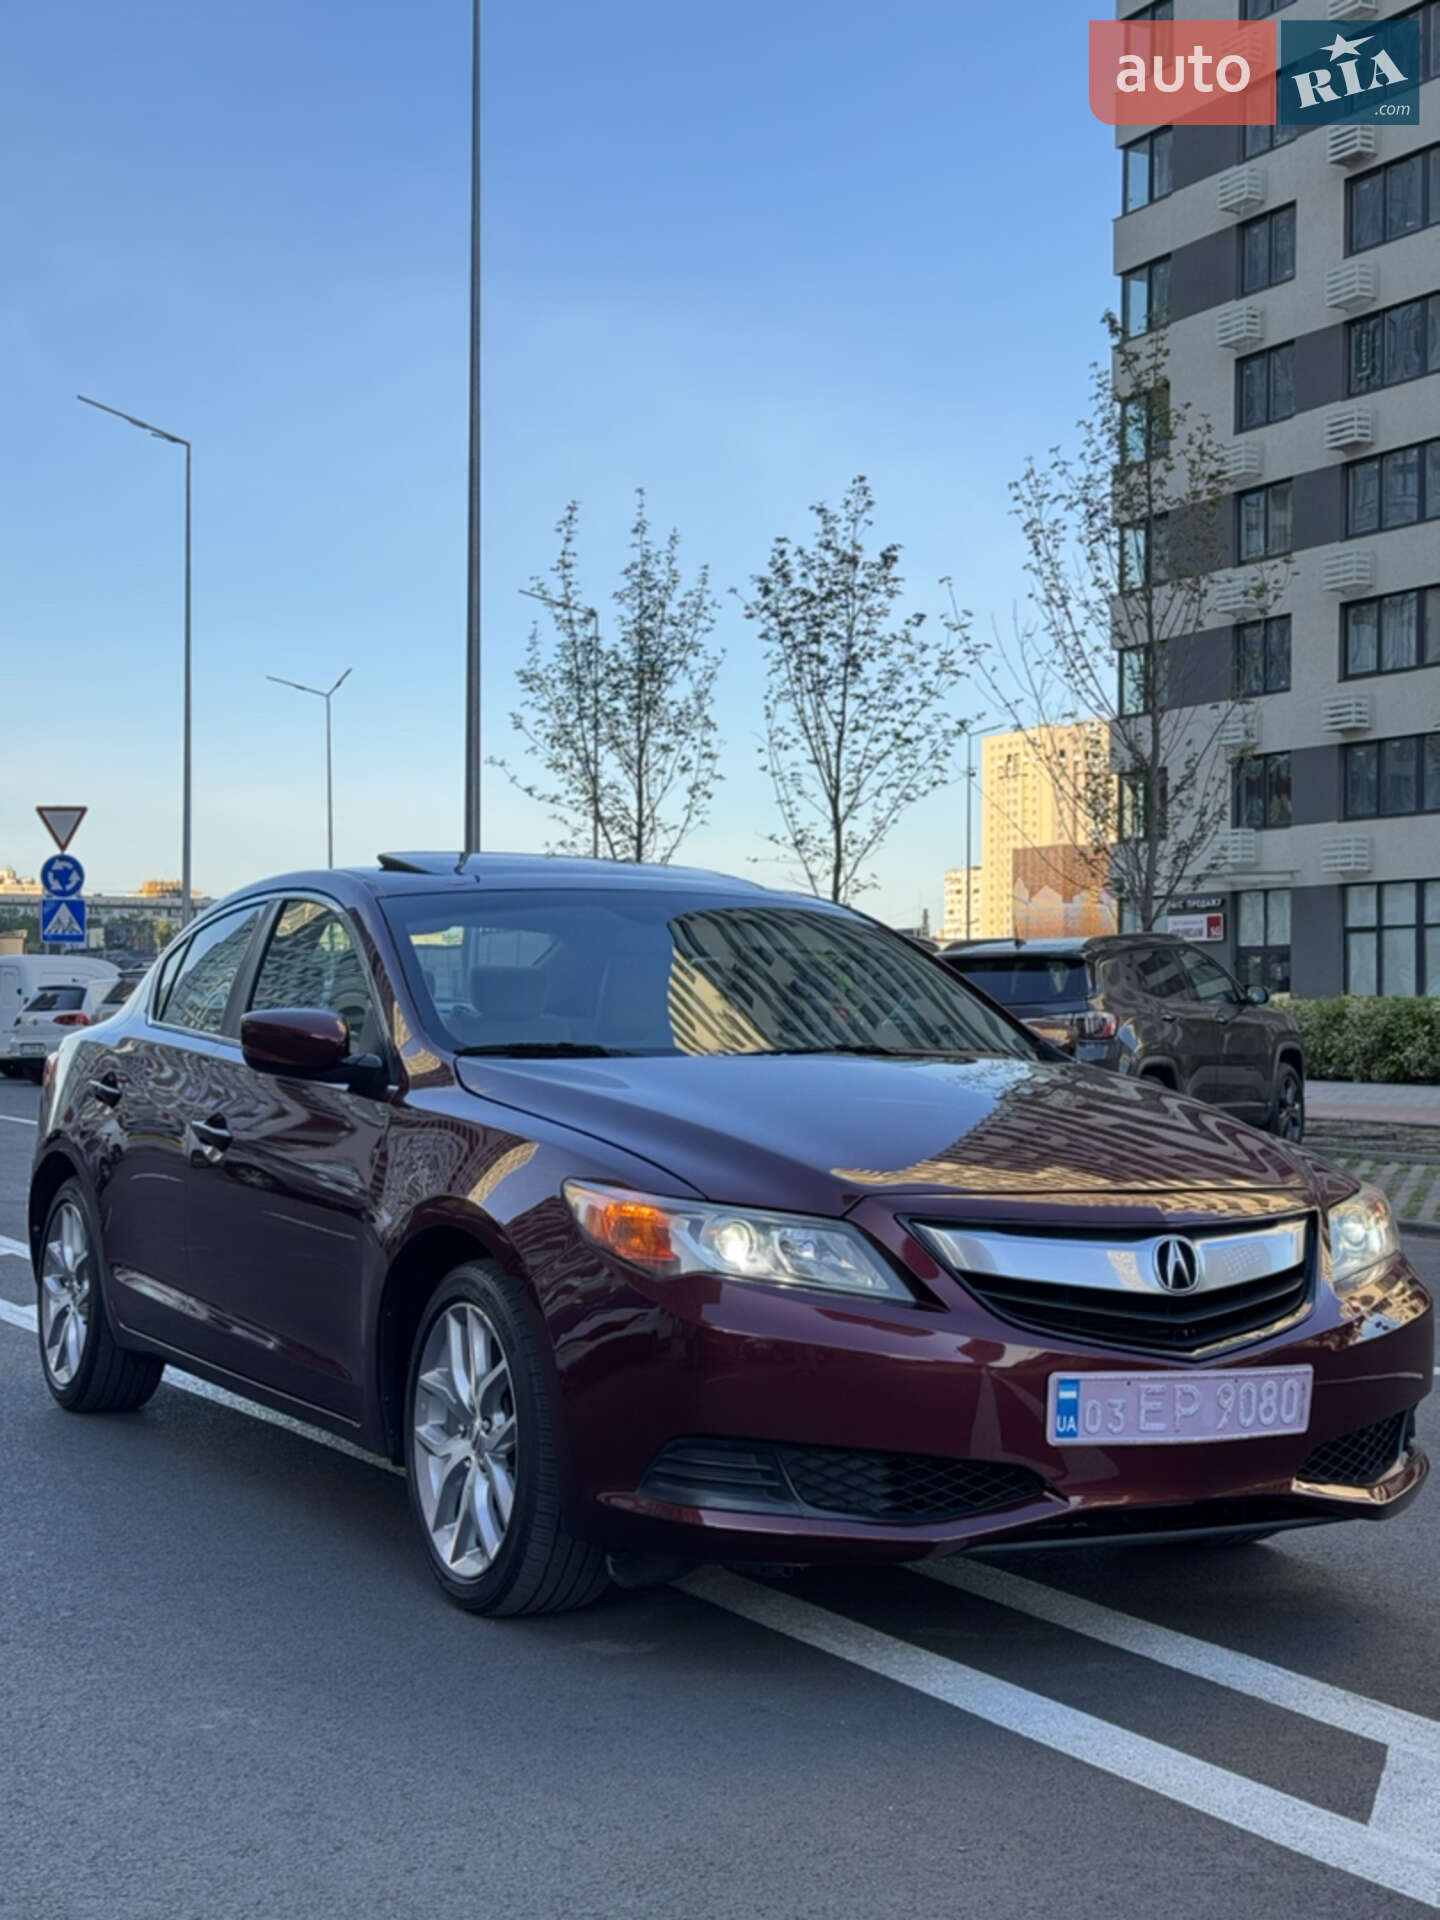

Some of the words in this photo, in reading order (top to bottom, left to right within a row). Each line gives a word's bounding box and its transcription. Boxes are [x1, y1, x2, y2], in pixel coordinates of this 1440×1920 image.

[1084, 1399, 1126, 1433] 03
[1216, 1379, 1299, 1430] 9080
[1056, 1416, 1077, 1432] UA
